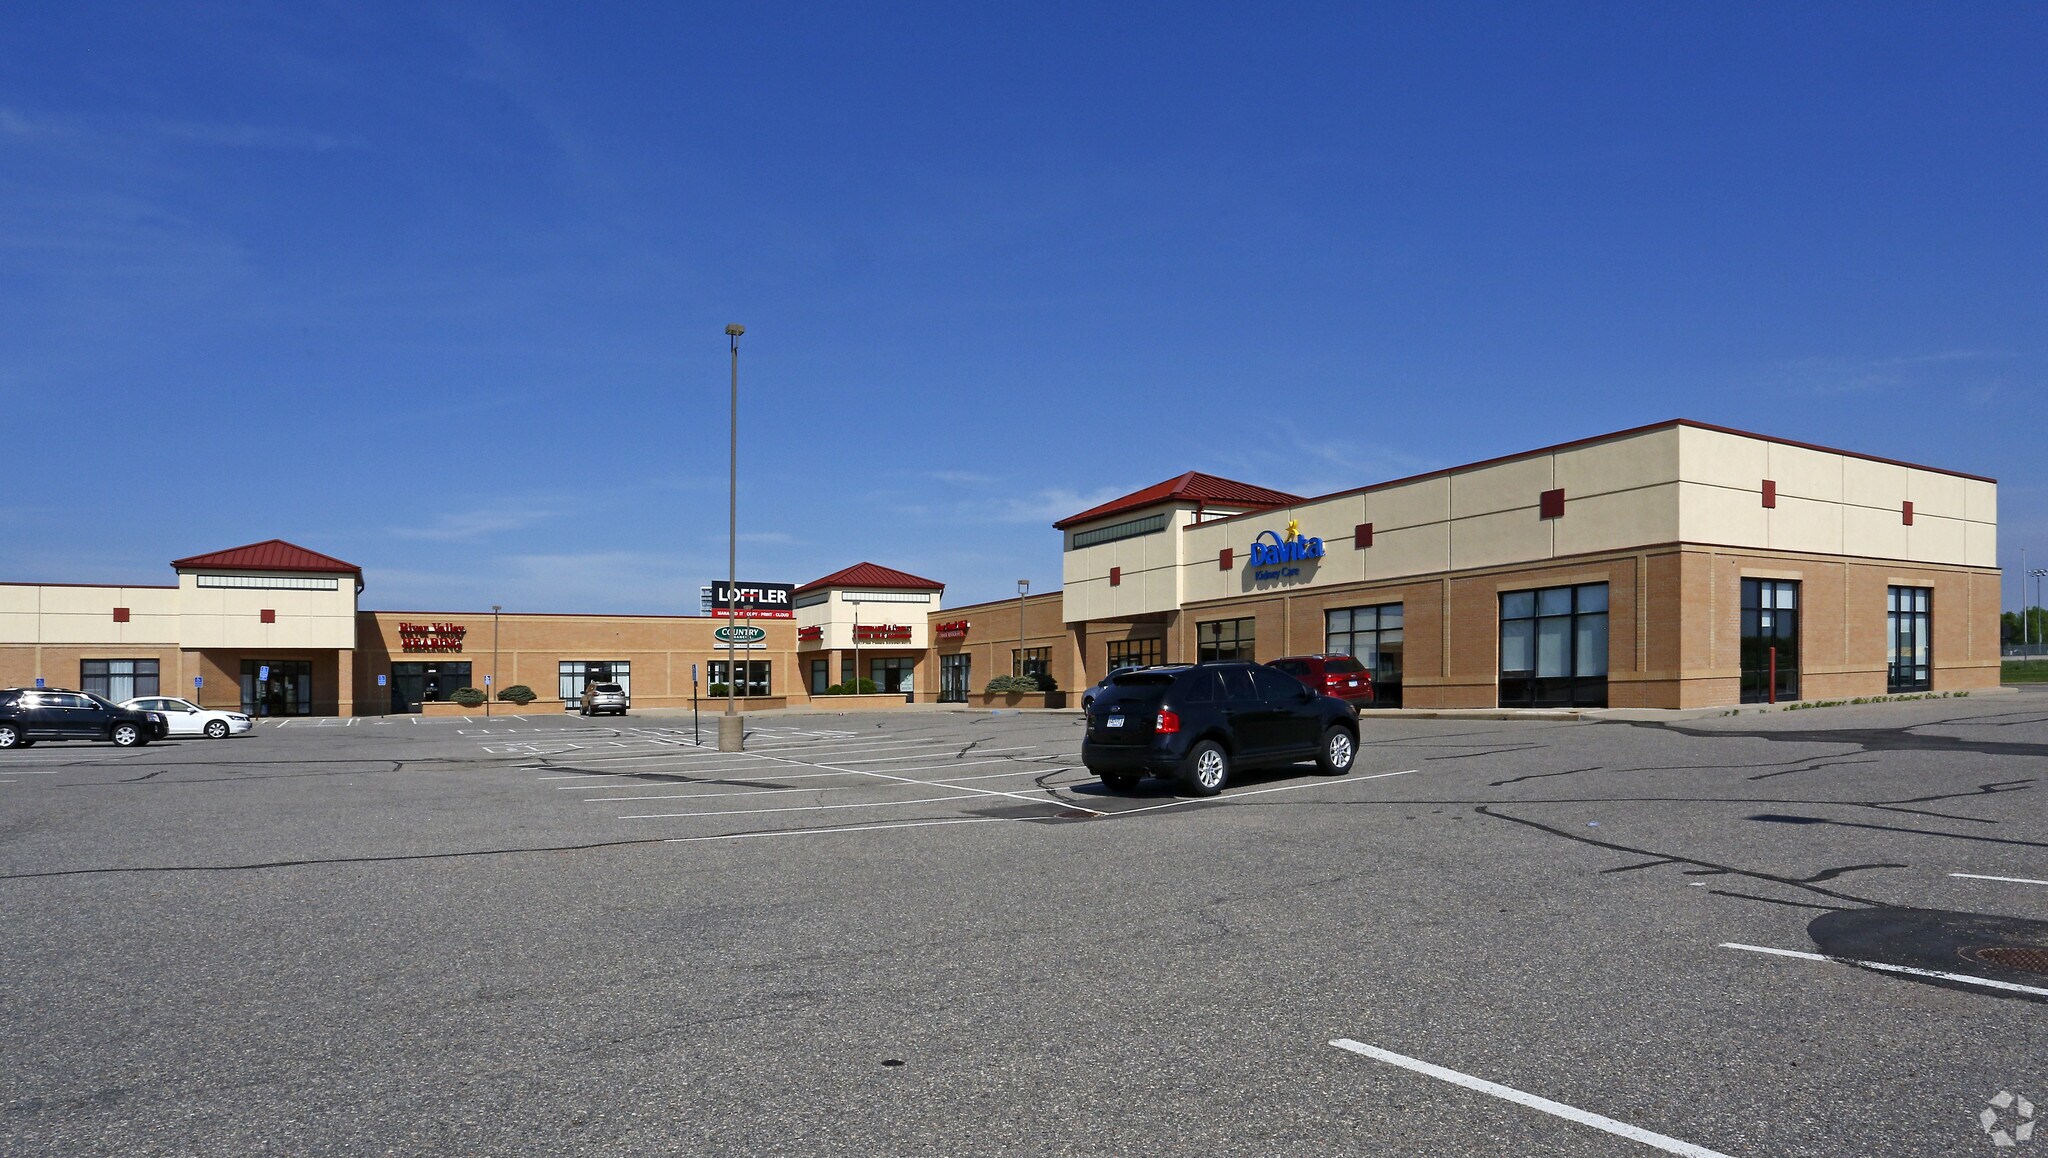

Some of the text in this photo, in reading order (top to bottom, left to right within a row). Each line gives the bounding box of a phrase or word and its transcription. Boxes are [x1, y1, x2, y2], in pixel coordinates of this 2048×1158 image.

[1251, 525, 1325, 567] DaVita
[1255, 566, 1300, 581] Kidney Care
[718, 587, 788, 604] LOFFLER
[432, 622, 466, 635] Valley
[721, 628, 759, 636] COUNTRY
[402, 637, 463, 649] HEARING
